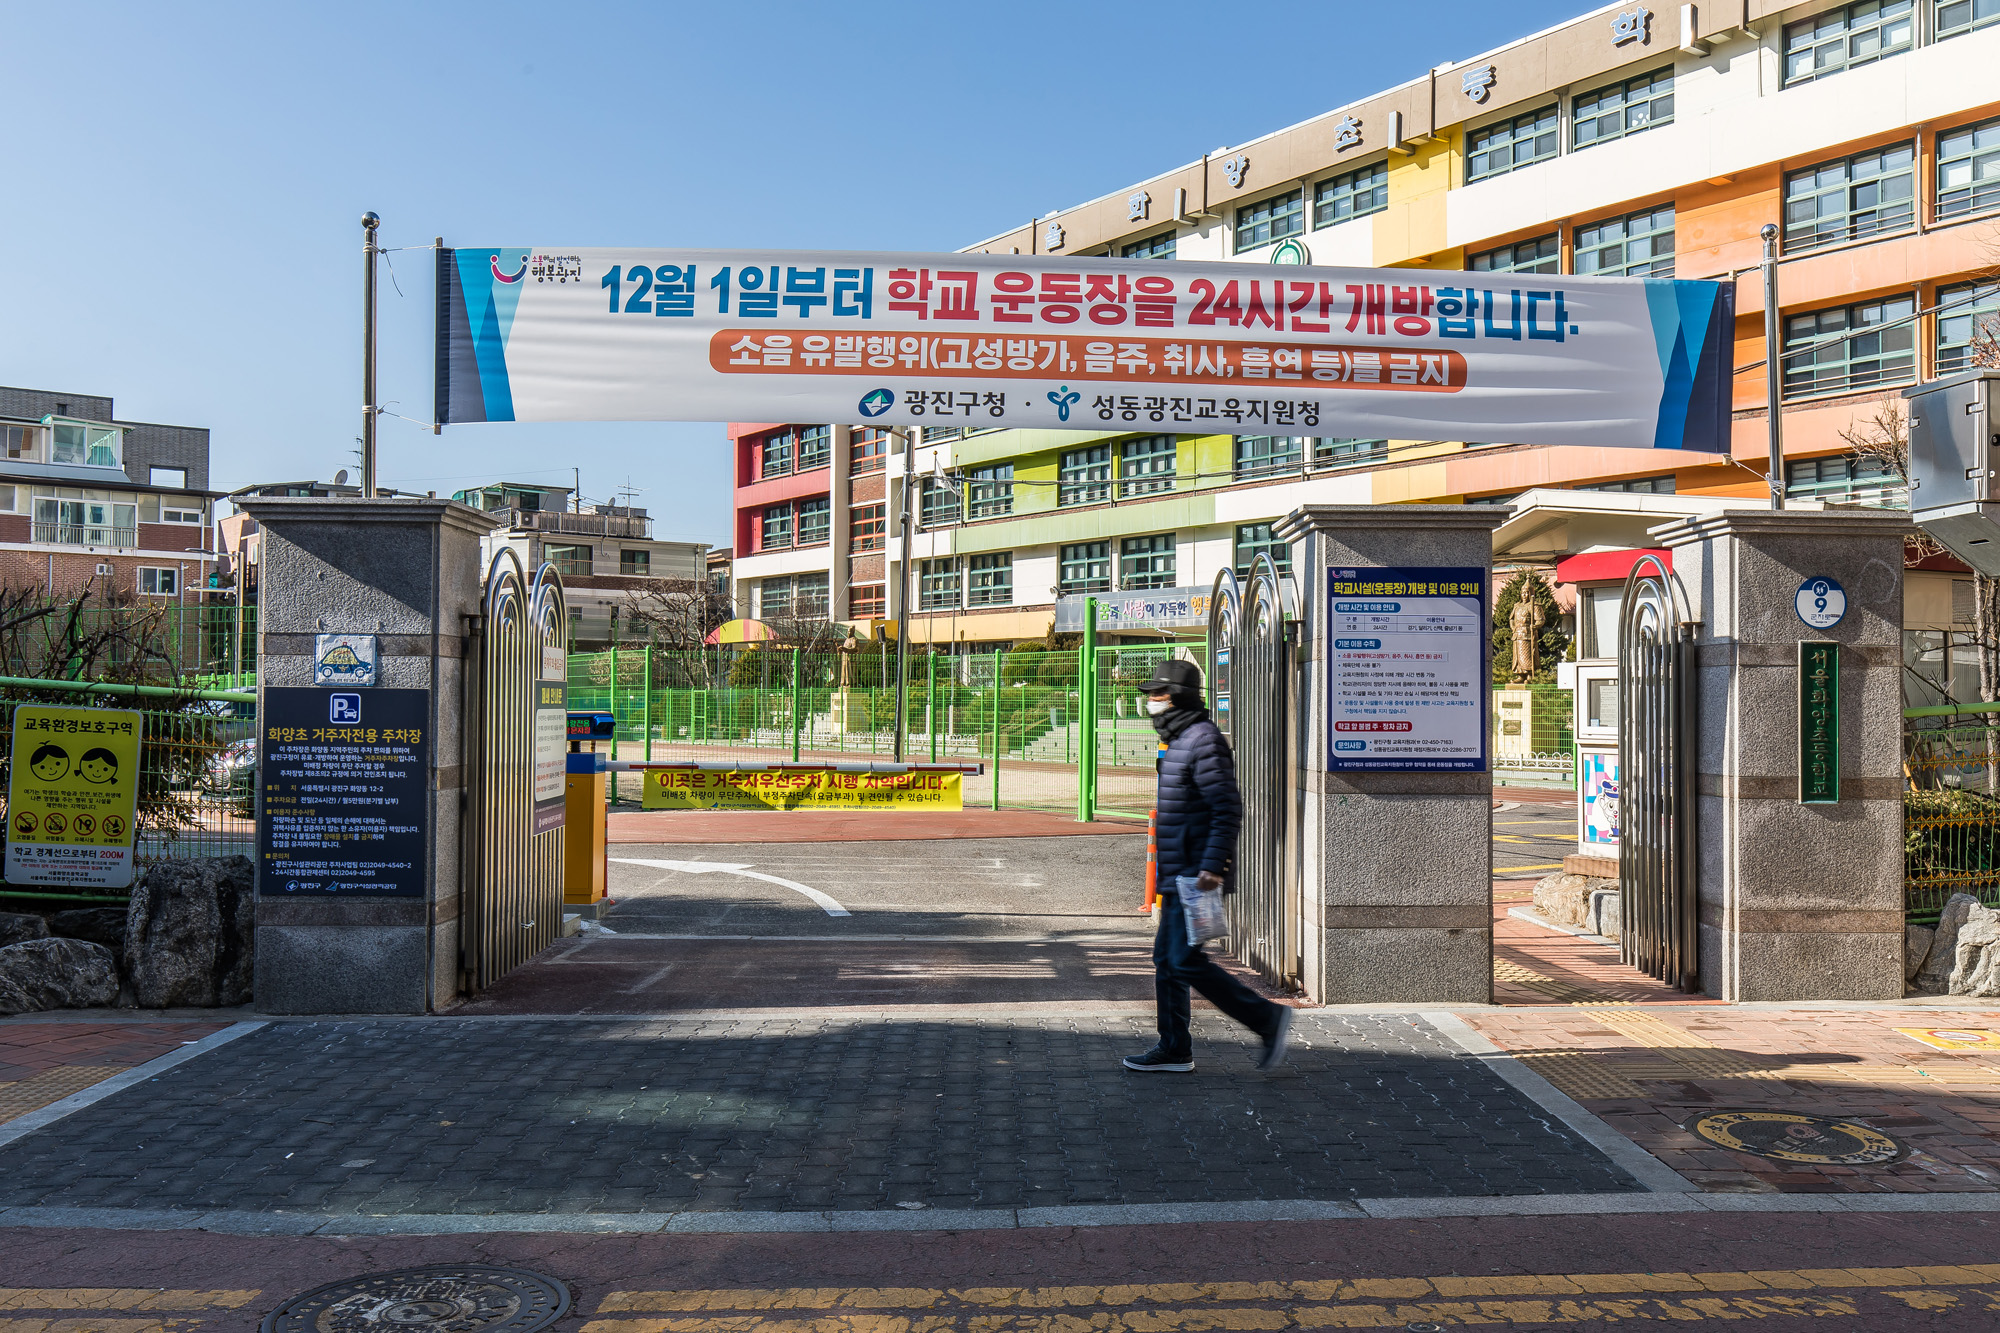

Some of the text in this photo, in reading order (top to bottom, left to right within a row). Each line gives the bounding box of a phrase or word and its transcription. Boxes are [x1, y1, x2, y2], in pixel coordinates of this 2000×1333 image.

[532, 265, 581, 283] 행복광진
[600, 264, 1579, 343] 12월 1일부터 학교 운동장을 24시간 개방합니다.
[729, 336, 1450, 386] 소음 유발행위(고성방가, 음주, 취사, 흡연 등)를 금지
[904, 389, 1321, 426] 광진구청 성동광진교육지원청
[1334, 582, 1479, 595] 학교시설(운동장) 개방 및 이용 안내
[1124, 600, 1154, 619] 사랑이
[1159, 601, 1187, 616] 가득한
[1814, 598, 1827, 613] 9
[24, 718, 132, 735] 교육환경보호구역
[1810, 650, 1830, 796] 서울화양초등학교
[268, 728, 422, 744] 화양초 거주자전용 주차장
[660, 773, 947, 790] 이곳은 거주자우선주차 시행 지역입니다.
[662, 791, 686, 799] 미배정
[690, 791, 715, 800] 차량이
[718, 791, 759, 800] 무단주차시
[763, 791, 854, 801] 부정주차단속(요금부과)
[868, 793, 892, 801] 견인될
[896, 793, 904, 801] 수
[908, 793, 944, 802] 있습니다.
[15, 847, 124, 859] 학교 경계선으로부터 200M
